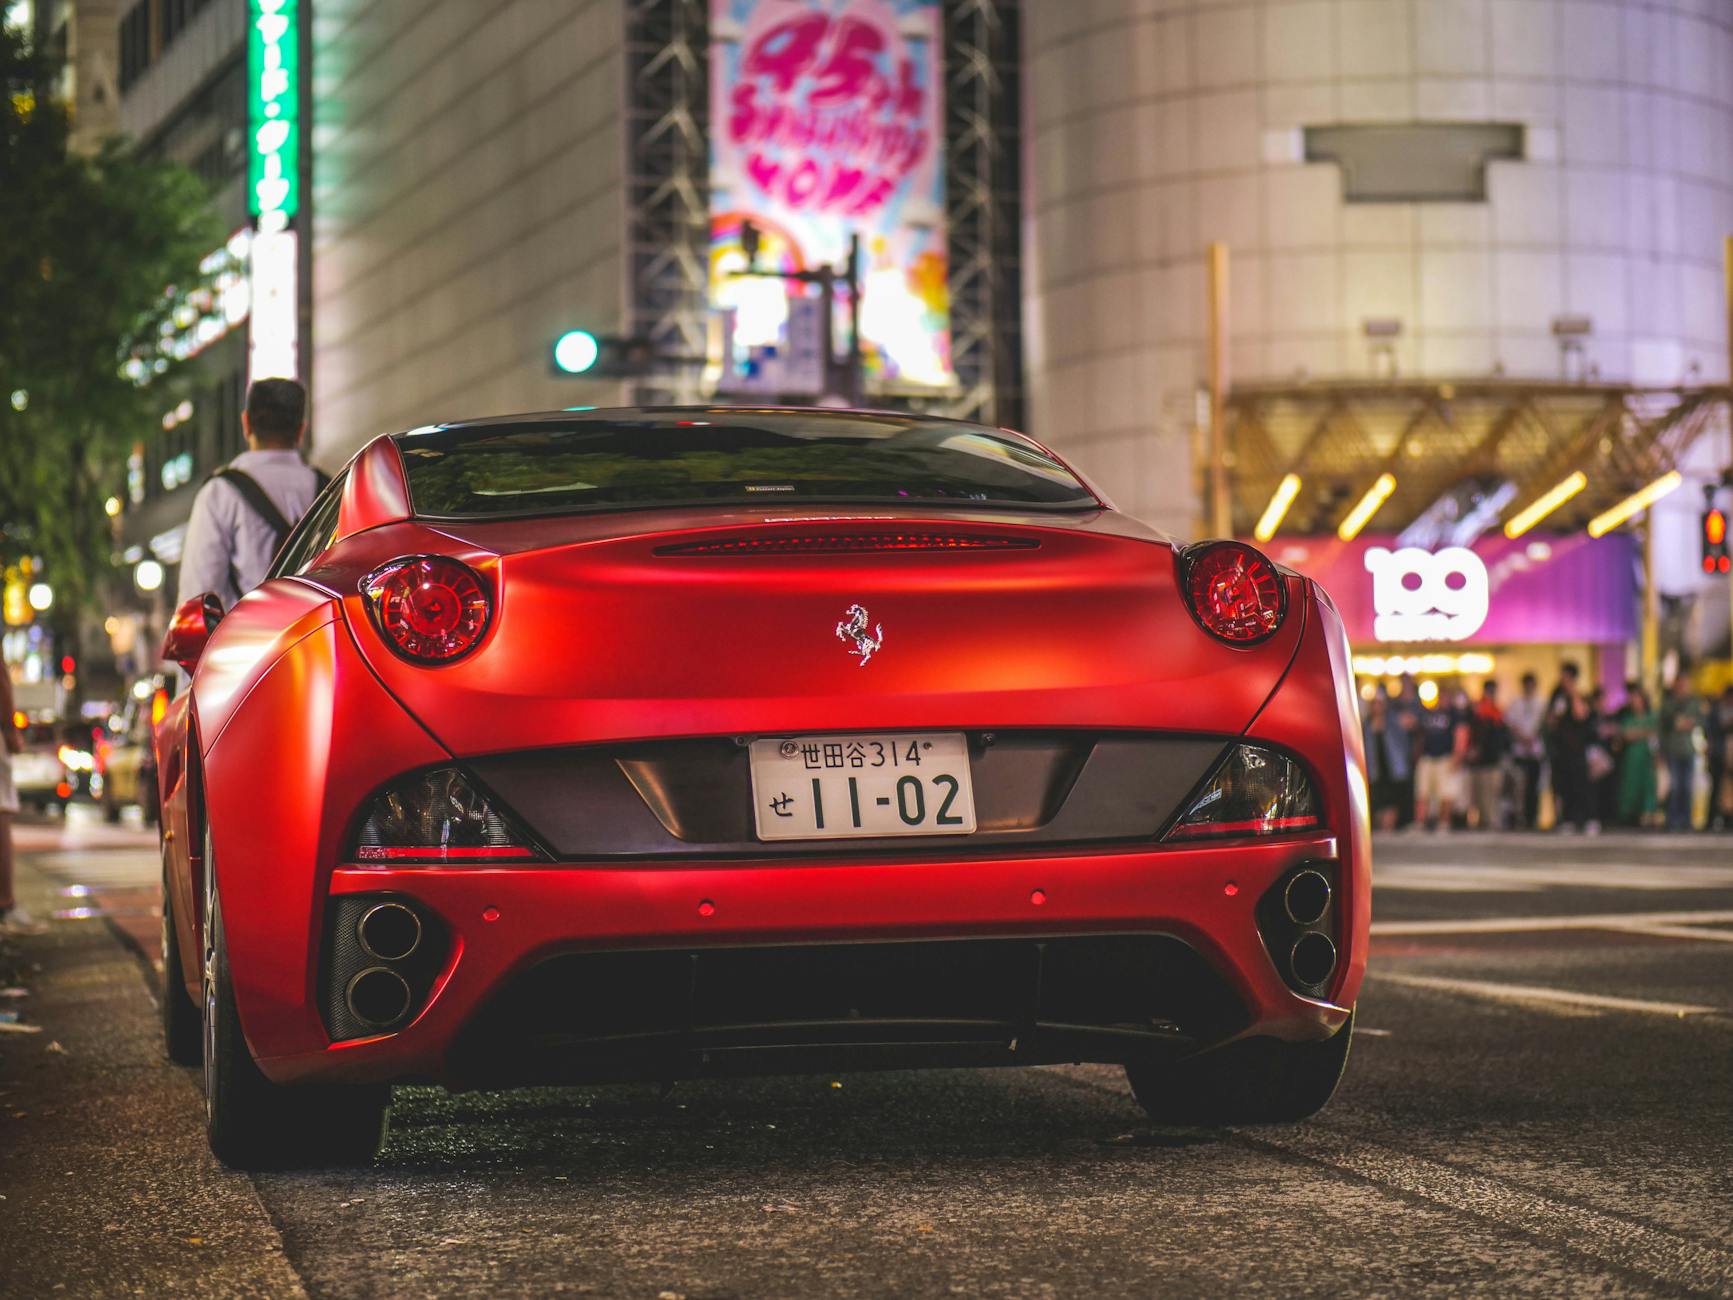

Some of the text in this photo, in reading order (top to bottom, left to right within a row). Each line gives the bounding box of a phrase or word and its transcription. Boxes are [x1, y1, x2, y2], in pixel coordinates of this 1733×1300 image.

[1365, 547, 1488, 640] 109
[769, 774, 963, 829] せ 11-02
